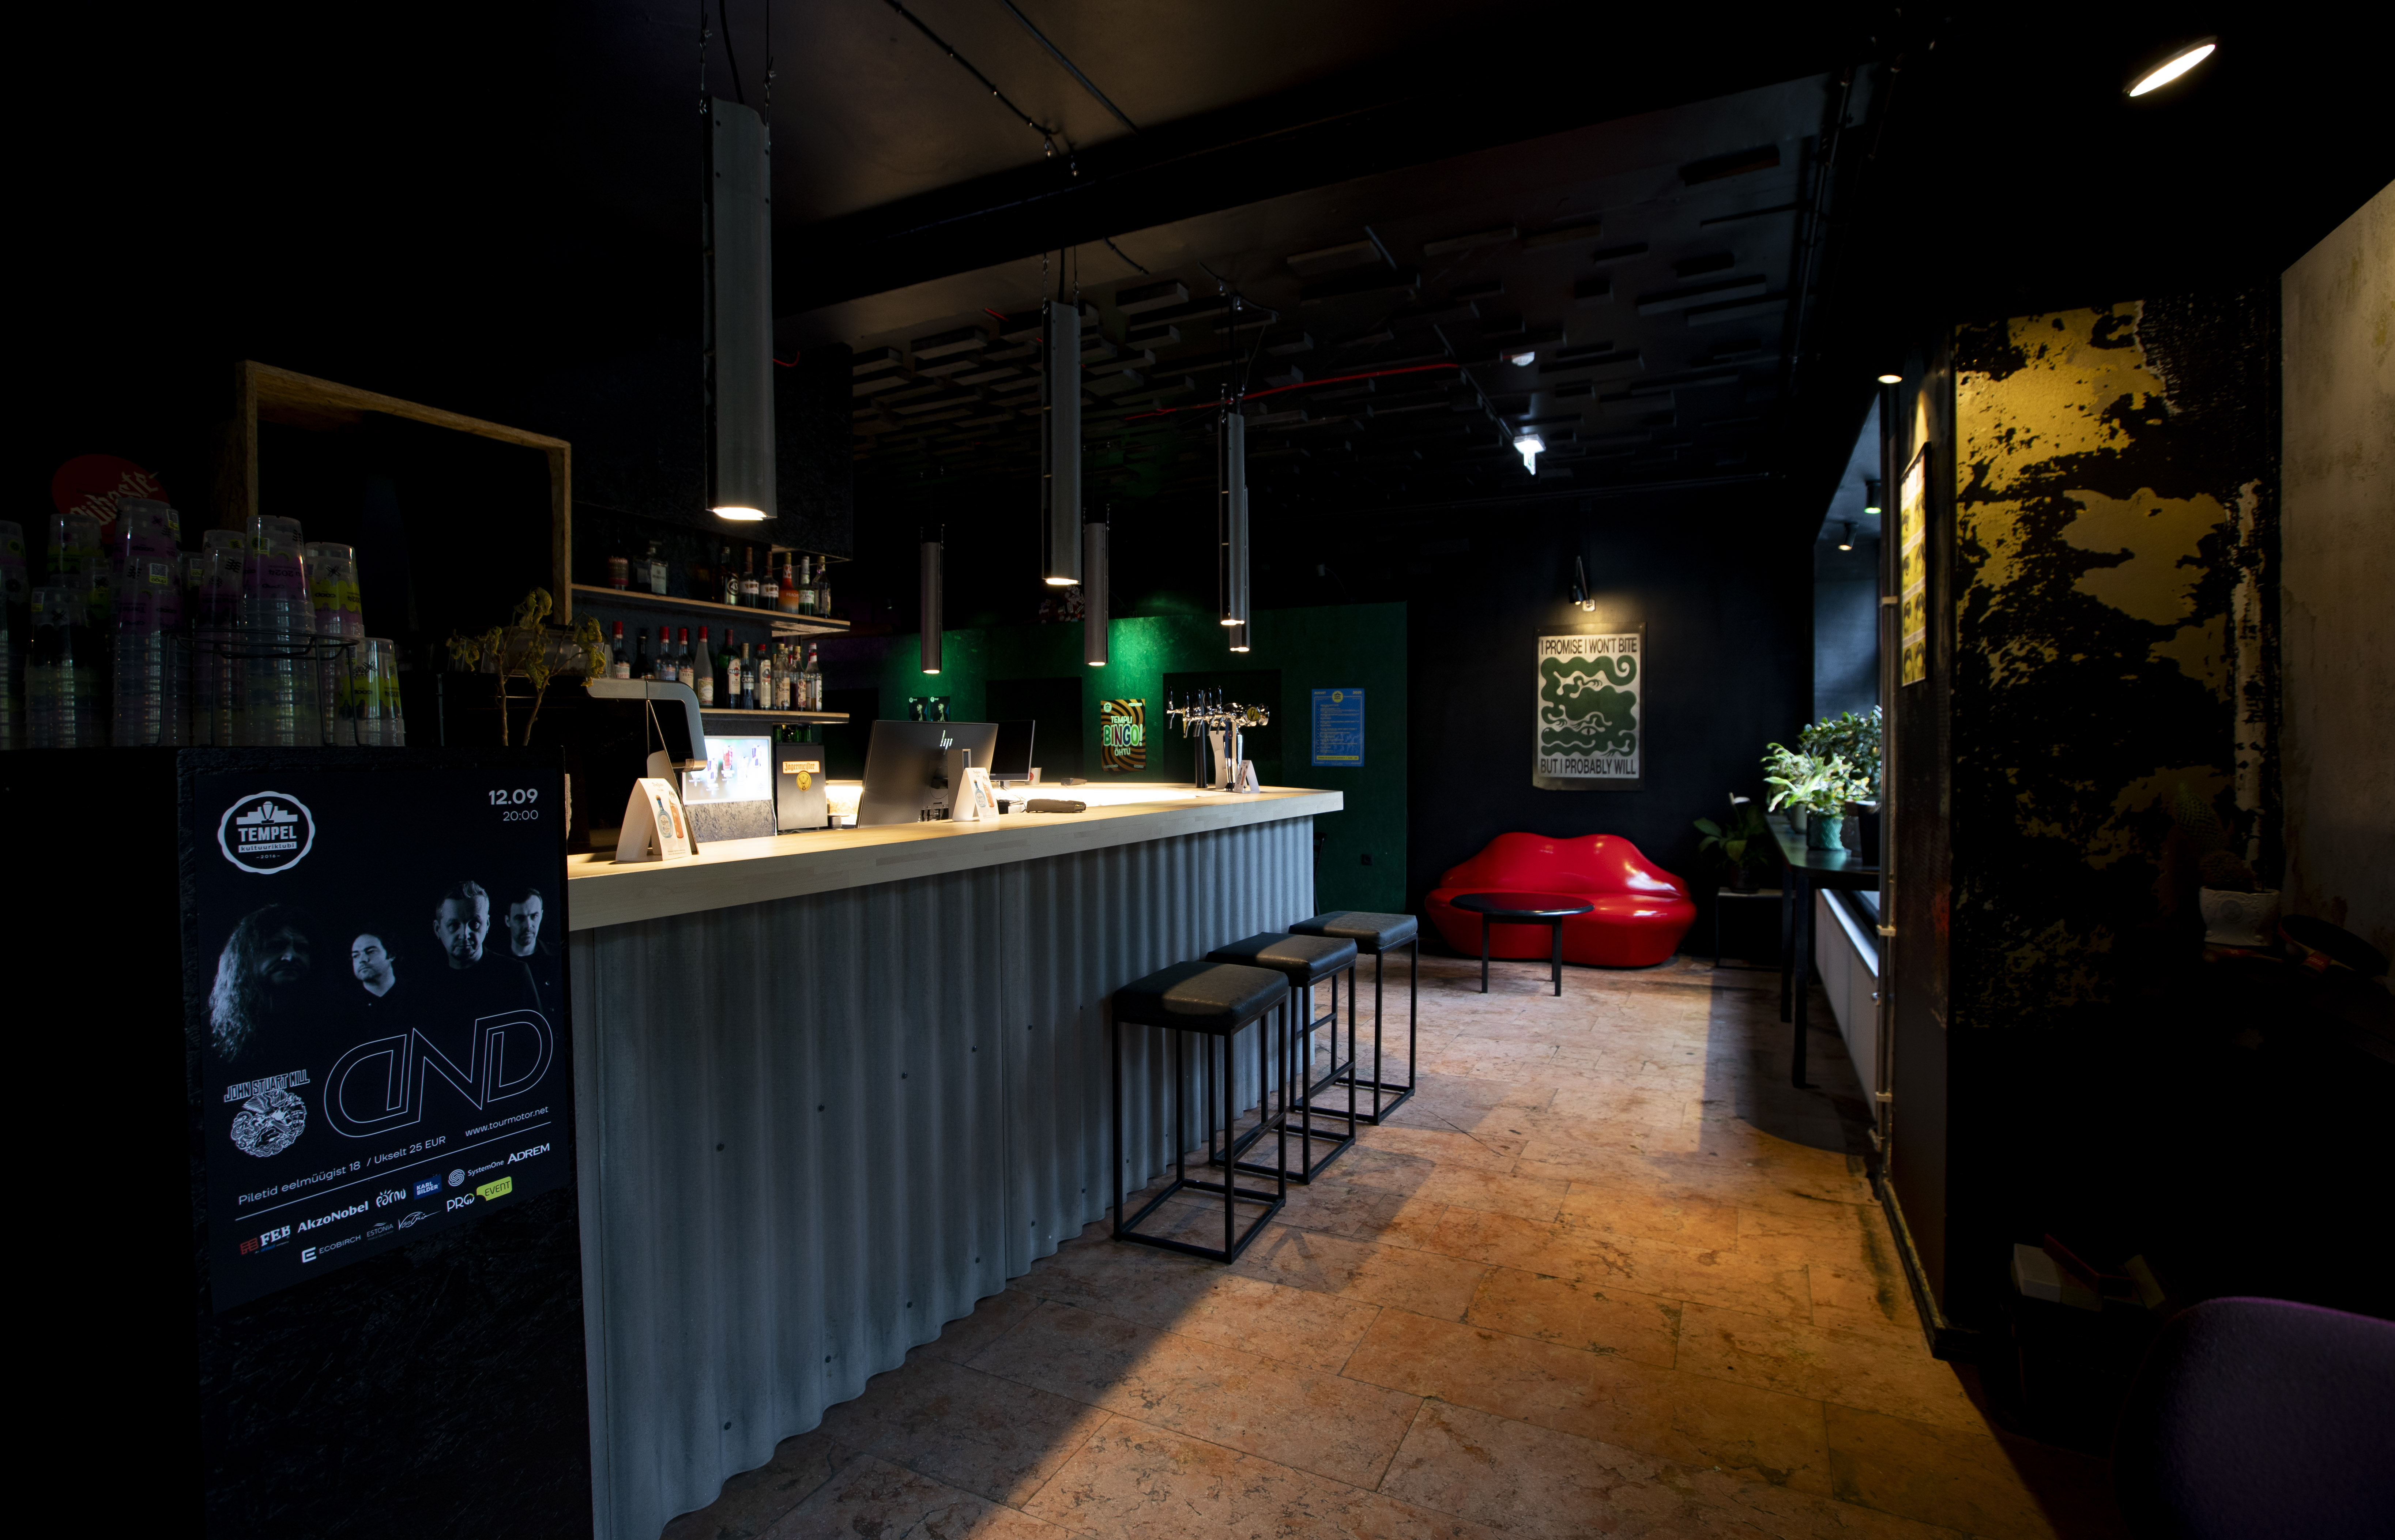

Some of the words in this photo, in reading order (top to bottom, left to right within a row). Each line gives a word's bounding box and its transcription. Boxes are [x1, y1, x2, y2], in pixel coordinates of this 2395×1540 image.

[1541, 640, 1544, 654] I
[1546, 639, 1582, 654] PROMISE
[1585, 638, 1587, 653] I
[1589, 638, 1617, 654] WON'T
[1619, 637, 1637, 652] BITE
[1111, 716, 1132, 724] TEMPLI
[1103, 723, 1143, 747] BINGO!
[1114, 747, 1130, 756] ÕHTU
[1541, 758, 1558, 774] BUT
[1560, 758, 1563, 774] I
[1565, 758, 1612, 774] PROBABLY
[1615, 759, 1636, 775] WILL
[489, 788, 538, 805] 12.09
[503, 810, 538, 821] 20:00
[238, 825, 297, 842] TEMPEL
[241, 843, 294, 852] kultuuriklubi
[224, 1081, 251, 1103] JOHN
[252, 1073, 289, 1096] STUART
[289, 1069, 310, 1088] MILL
[465, 1106, 549, 1137] www.tourmotor.net
[507, 1142, 550, 1165] ADREM
[238, 1185, 278, 1205] Piletid
[281, 1166, 347, 1192] eelmüügist
[349, 1161, 361, 1172] 18
[374, 1148, 407, 1165] Ukselt
[409, 1144, 422, 1155] 25
[425, 1136, 446, 1149] EUR
[467, 1159, 504, 1177] SystemOne
[416, 1181, 433, 1190] KARL
[416, 1184, 438, 1196] BILDER
[297, 1200, 369, 1234] AkzoNobel
[260, 1225, 291, 1247] FEB
[366, 1223, 394, 1238] ESTONIA
[319, 1234, 361, 1254] ECOBIRCH
